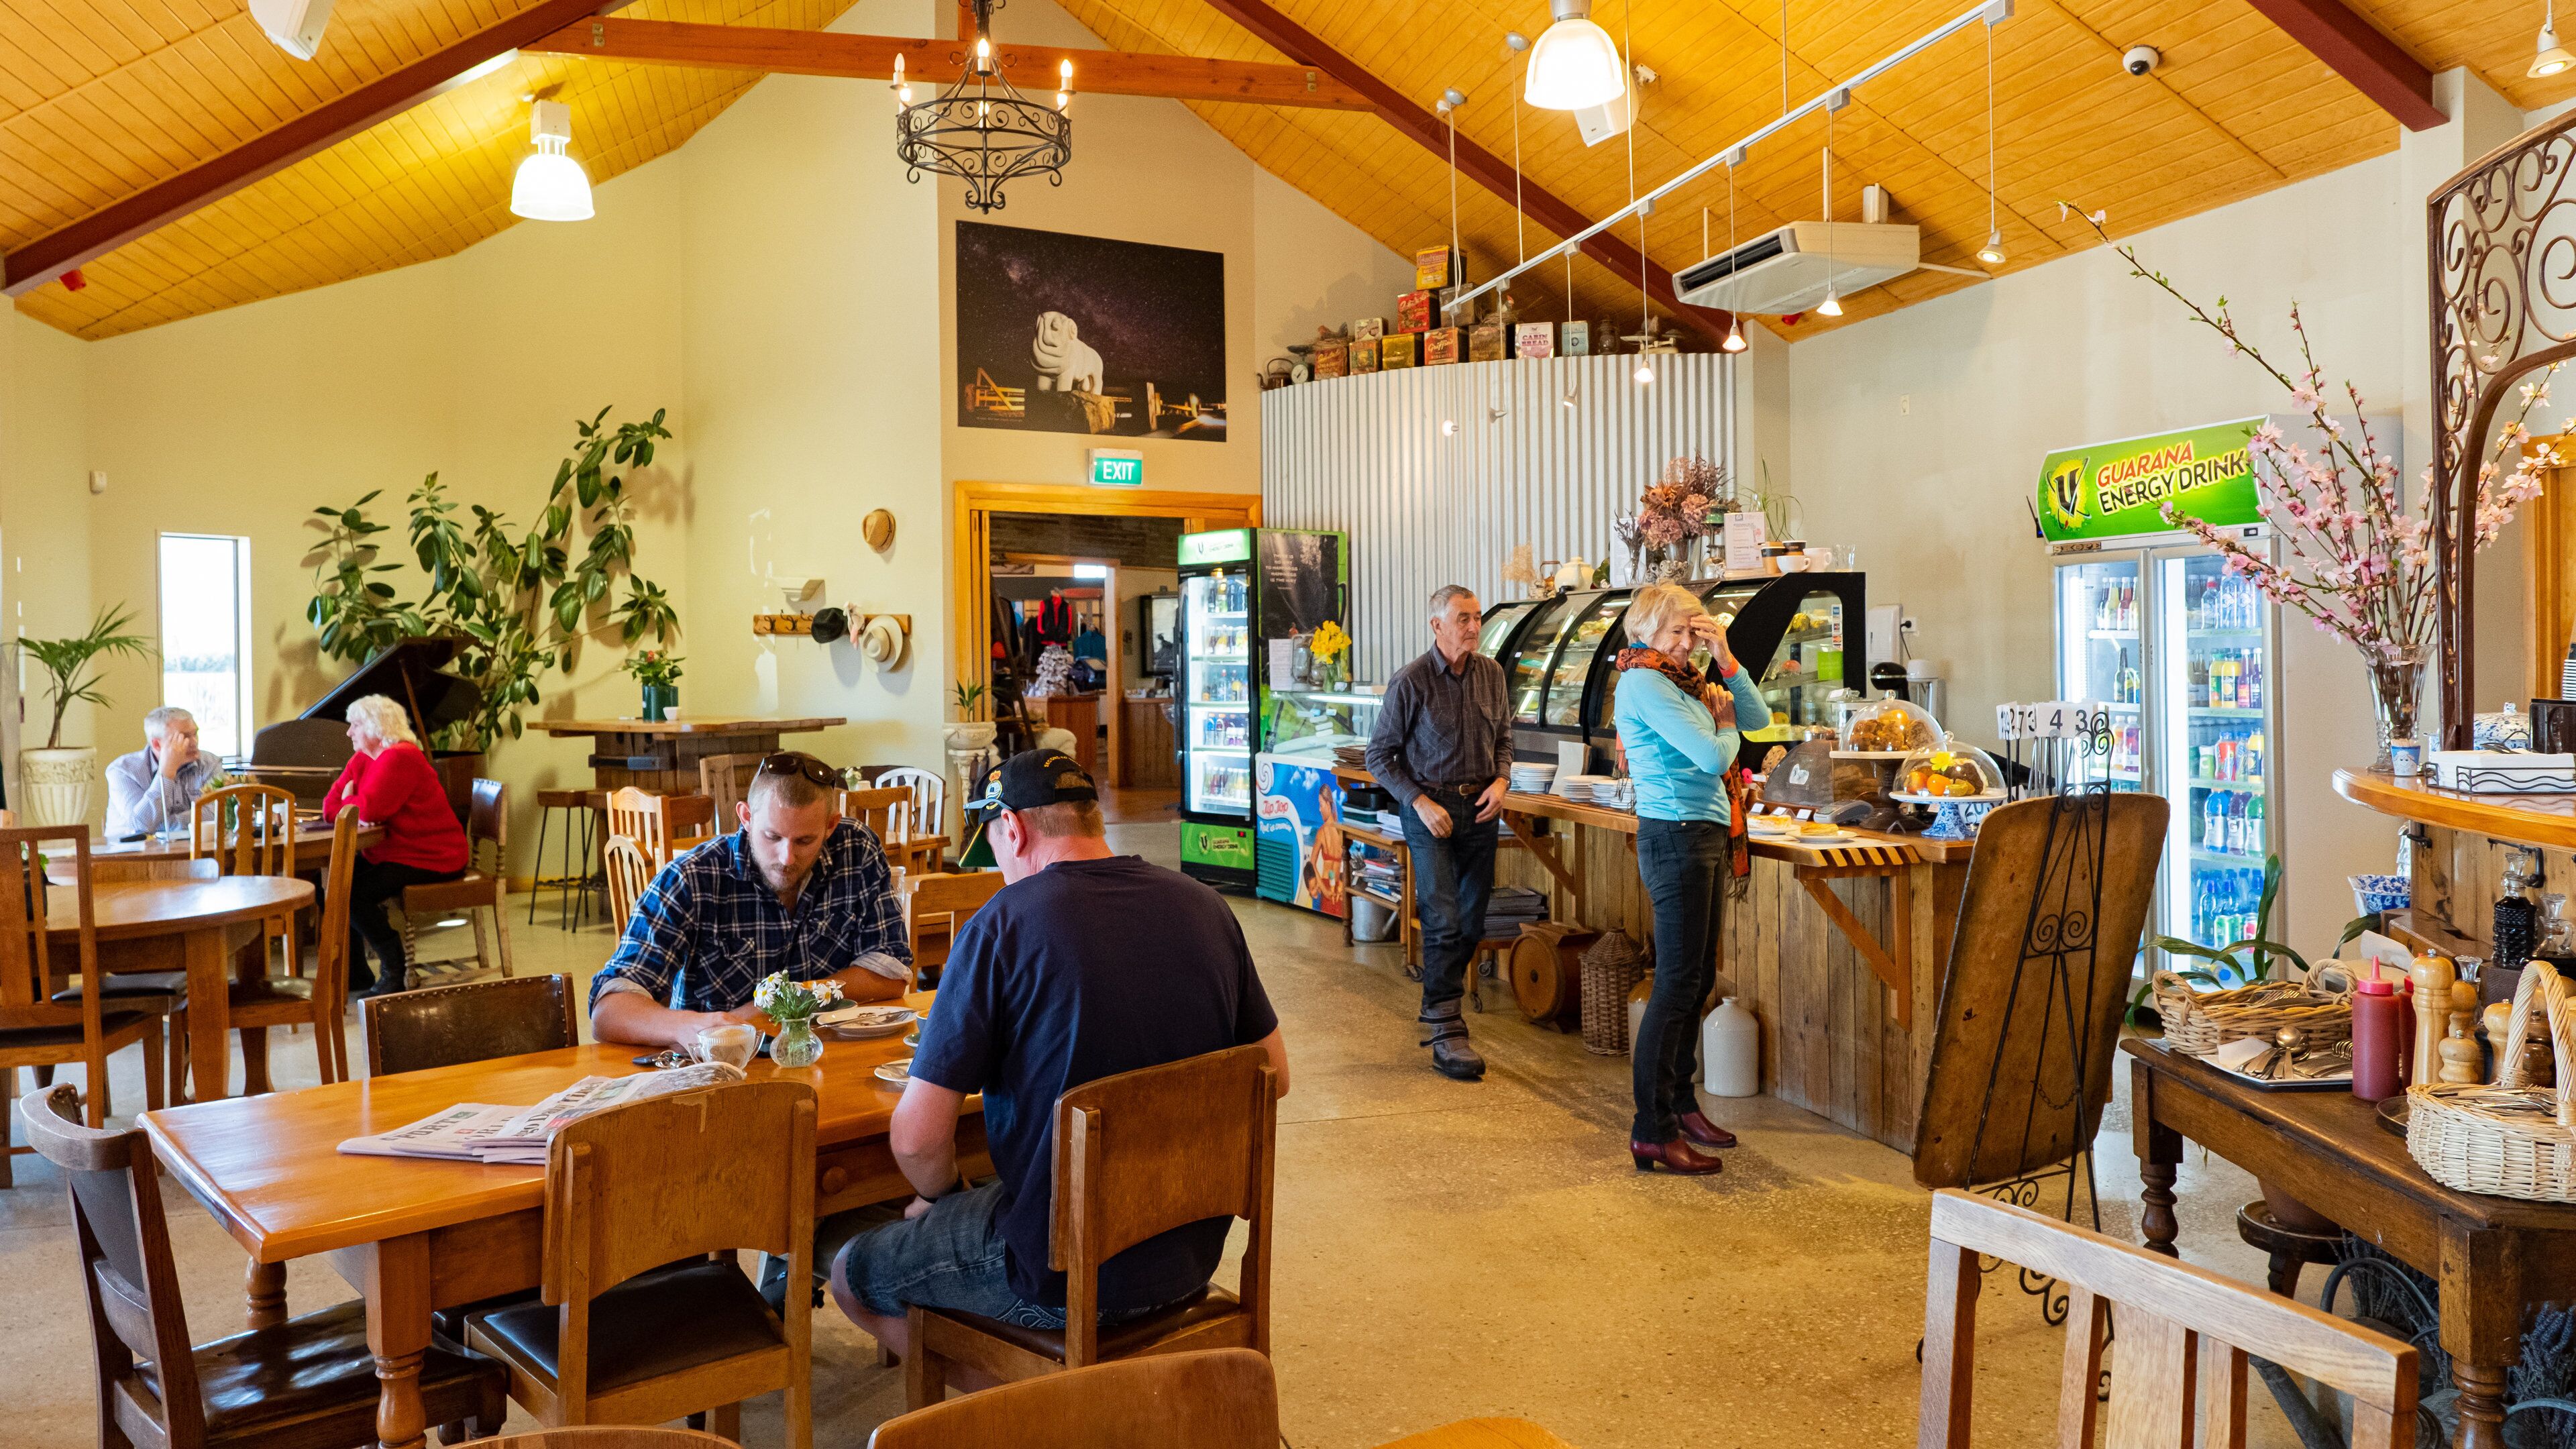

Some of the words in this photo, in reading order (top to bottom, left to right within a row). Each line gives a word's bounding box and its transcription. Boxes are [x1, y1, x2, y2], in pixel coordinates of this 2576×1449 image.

[1103, 461, 1135, 481] EXIT
[2098, 441, 2193, 488] GUARANA
[2099, 471, 2175, 513] ENERGY
[2180, 450, 2245, 490] DRINK
[2051, 464, 2084, 520] V
[2050, 709, 2063, 733] 4
[2076, 710, 2088, 733] 3
